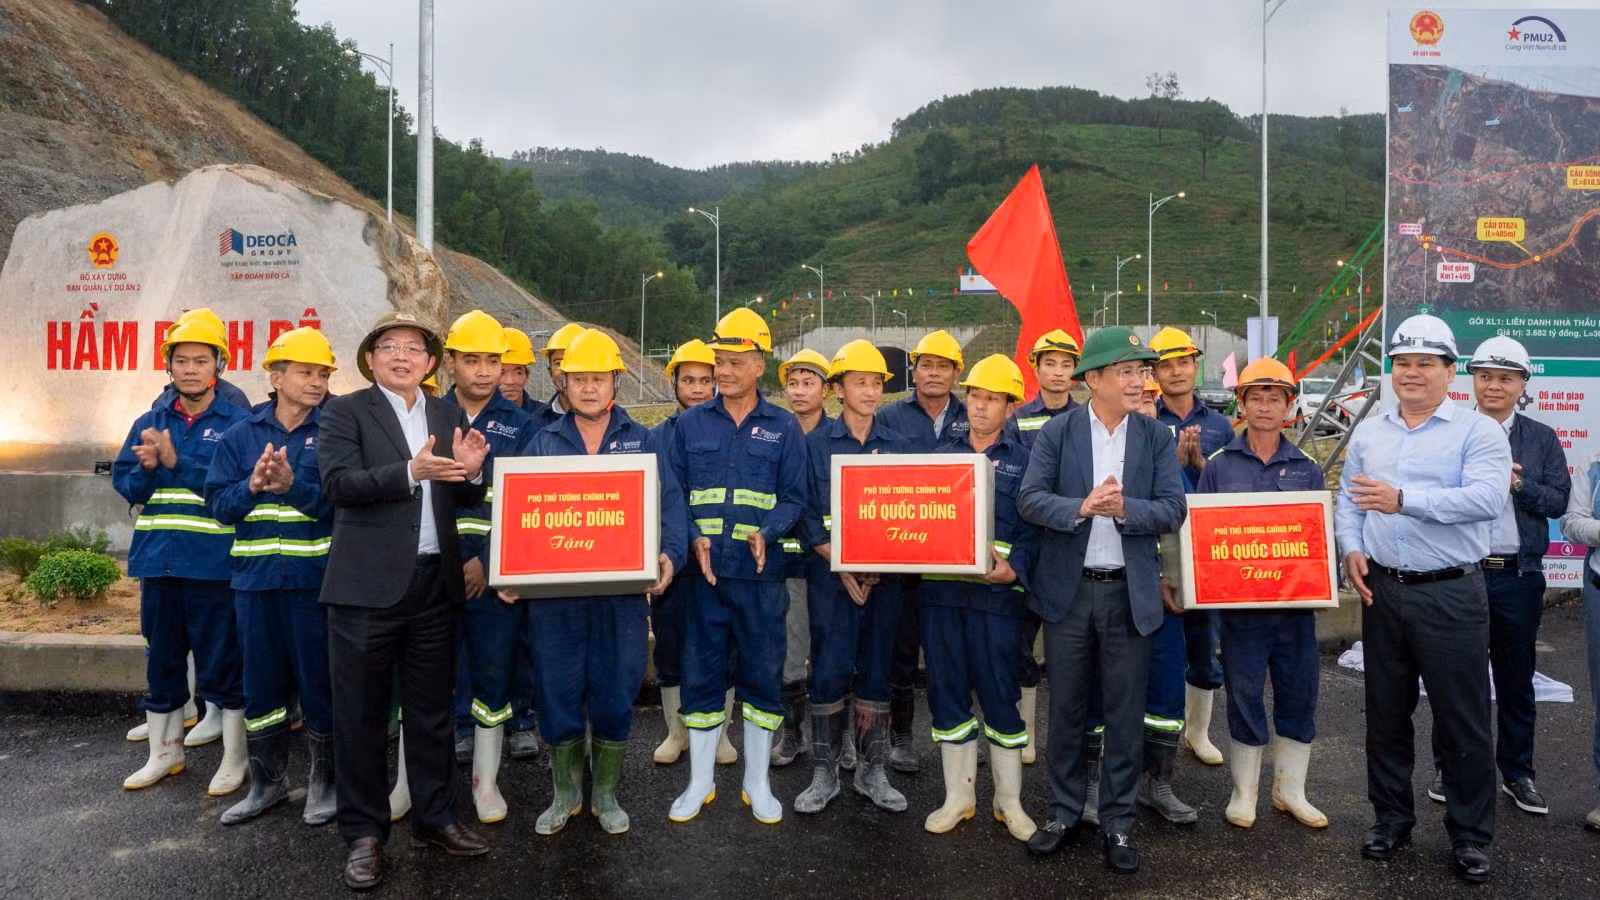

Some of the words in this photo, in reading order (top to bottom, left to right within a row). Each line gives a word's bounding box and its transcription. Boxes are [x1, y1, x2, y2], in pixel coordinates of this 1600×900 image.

[1523, 33, 1553, 42] PMU2
[80, 272, 90, 282] BỘ
[92, 272, 106, 281] XÂY
[107, 272, 127, 282] DỰNG
[66, 284, 80, 292] BAN
[82, 282, 102, 292] QUẢN
[1468, 317, 1484, 326] GÓI
[1506, 317, 1525, 326] LIÊN
[1527, 318, 1551, 326] DANH
[1553, 317, 1571, 327] NHÀ
[1574, 316, 1596, 327] THẦU
[46, 302, 138, 371] HẦM
[1497, 328, 1511, 336] Giá
[1512, 329, 1524, 337] trị:
[1539, 391, 1549, 400] 06
[1551, 390, 1565, 400] nút
[1566, 390, 1584, 402] giao
[1539, 401, 1554, 411] liên
[1556, 401, 1580, 412] thông
[1570, 428, 1588, 438] chui
[863, 485, 877, 494] PHÓ
[879, 484, 891, 494] THỦ
[892, 484, 914, 494] TƯỚNG
[915, 484, 937, 494] CHÍNH
[937, 483, 951, 494] PHỦ
[527, 492, 542, 503] PHÓ
[544, 492, 557, 502] THỦ
[558, 491, 581, 502] TƯỚNG
[582, 491, 604, 501] CHÍNH
[605, 490, 621, 501] PHỦ
[858, 499, 877, 520] HỒ
[880, 498, 916, 521] QUỐC
[919, 501, 957, 520] DŨNG
[521, 507, 541, 529] HỒ
[544, 506, 583, 530] QUỐC
[586, 507, 625, 527] DŨNG
[1213, 525, 1228, 535] PHÓ
[1229, 524, 1242, 535] THỦ
[1243, 524, 1265, 534] TƯỚNG
[1266, 523, 1287, 534] CHÍNH
[1288, 522, 1302, 533] PHỦ
[885, 526, 928, 544] Tặng
[549, 535, 595, 551] Tặng
[1211, 539, 1229, 560] HỒ
[1232, 538, 1268, 560] QUỐC
[1271, 539, 1309, 558] DŨNG
[1549, 561, 1568, 570] pháp
[1239, 566, 1283, 581] Tặng
[1548, 571, 1566, 580] ĐÈO
